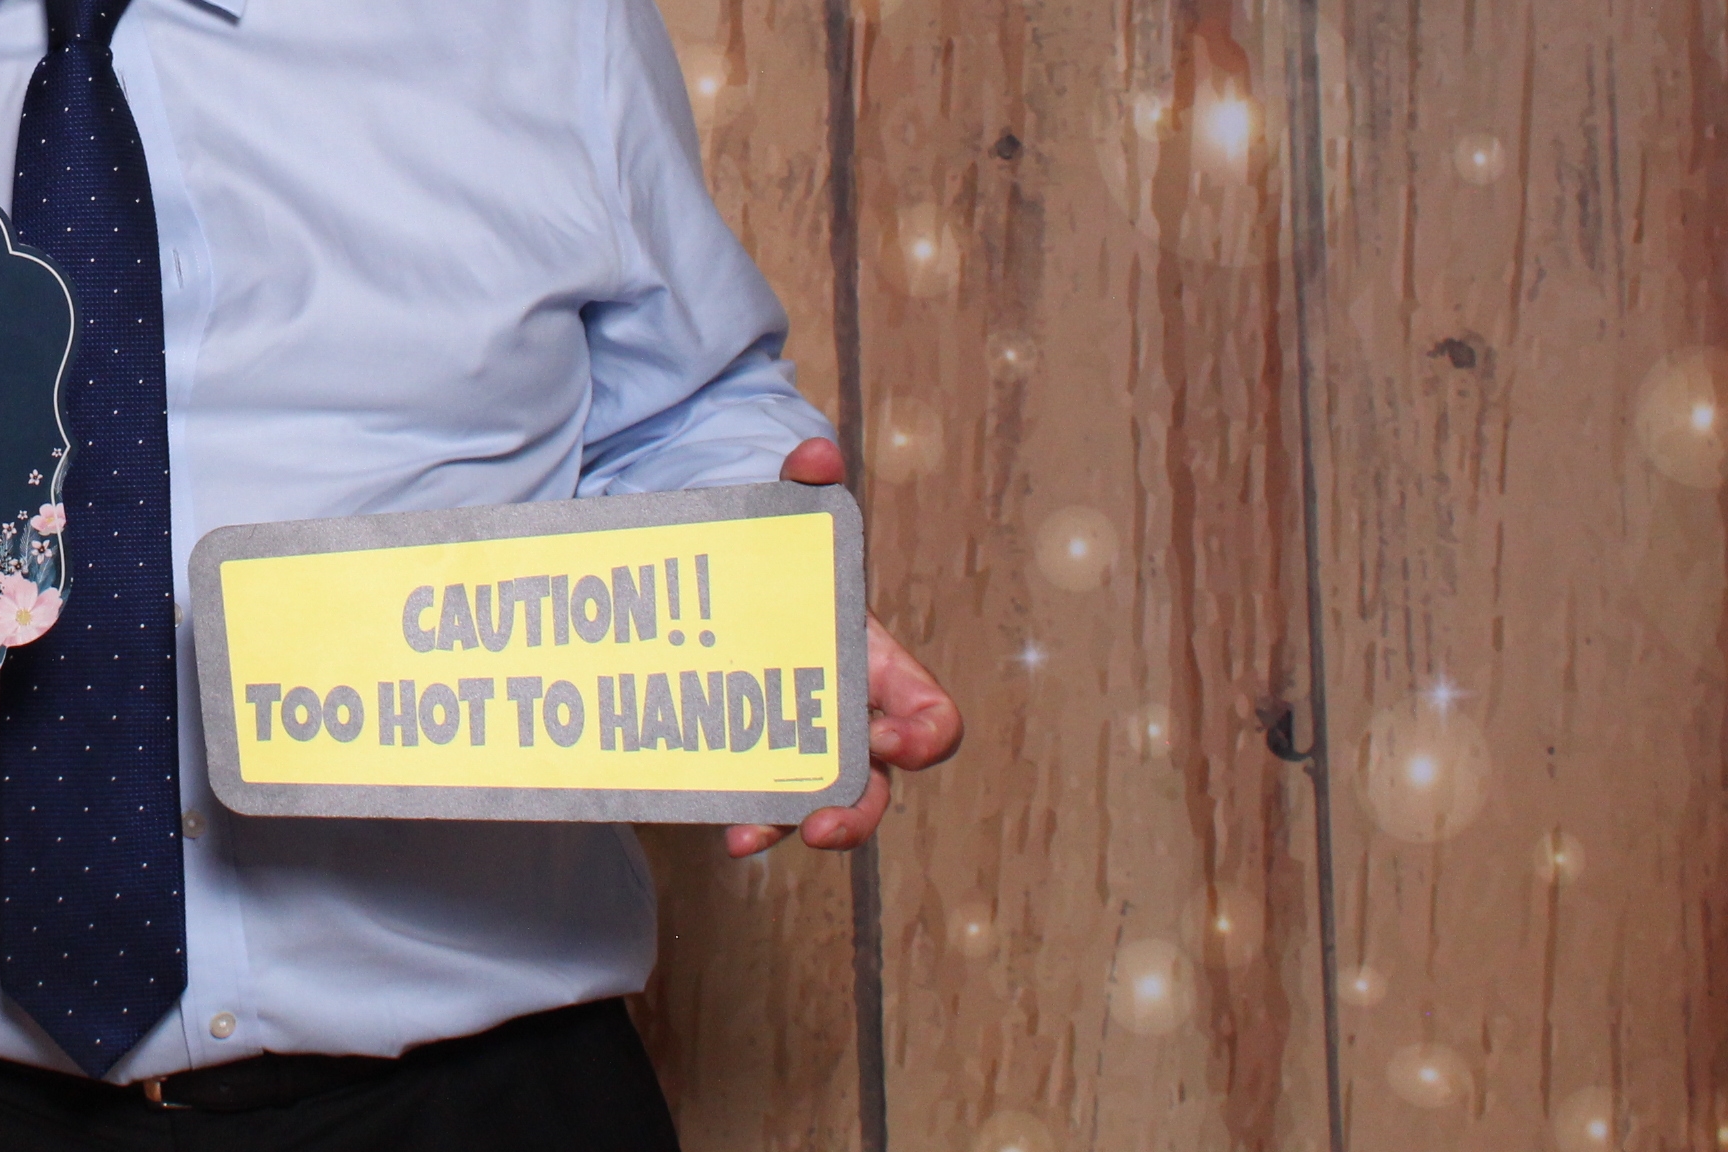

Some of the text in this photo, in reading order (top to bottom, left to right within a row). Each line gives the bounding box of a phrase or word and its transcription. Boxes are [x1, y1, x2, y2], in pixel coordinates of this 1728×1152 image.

[401, 553, 717, 654] CAUTION!!
[245, 666, 829, 756] TOO HOT TO HANDLE
